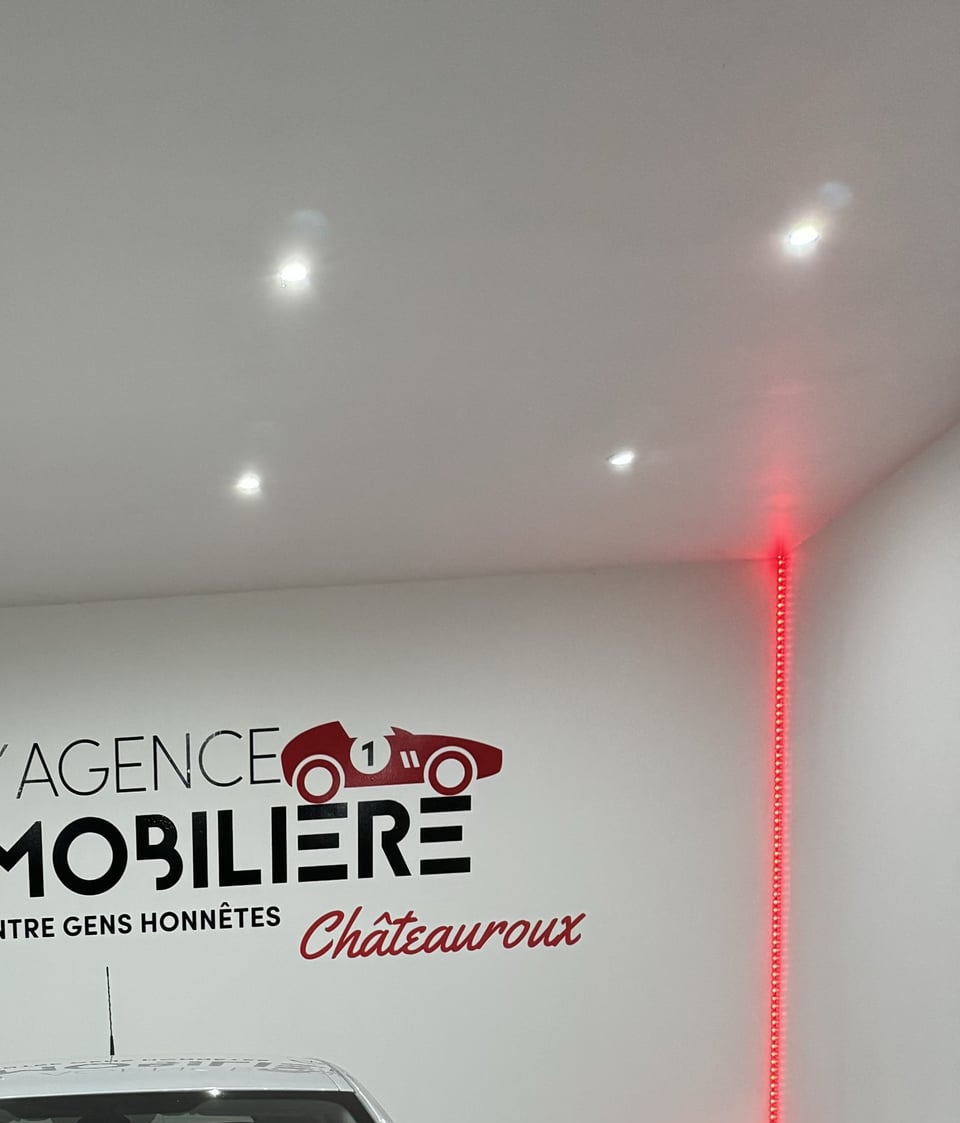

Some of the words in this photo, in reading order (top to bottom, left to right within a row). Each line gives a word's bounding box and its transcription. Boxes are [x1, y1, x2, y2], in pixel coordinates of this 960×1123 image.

[361, 741, 374, 767] 1
[62, 913, 132, 938] GENS
[141, 902, 281, 933] HONNÊTES
[299, 906, 586, 960] Châteauroux
